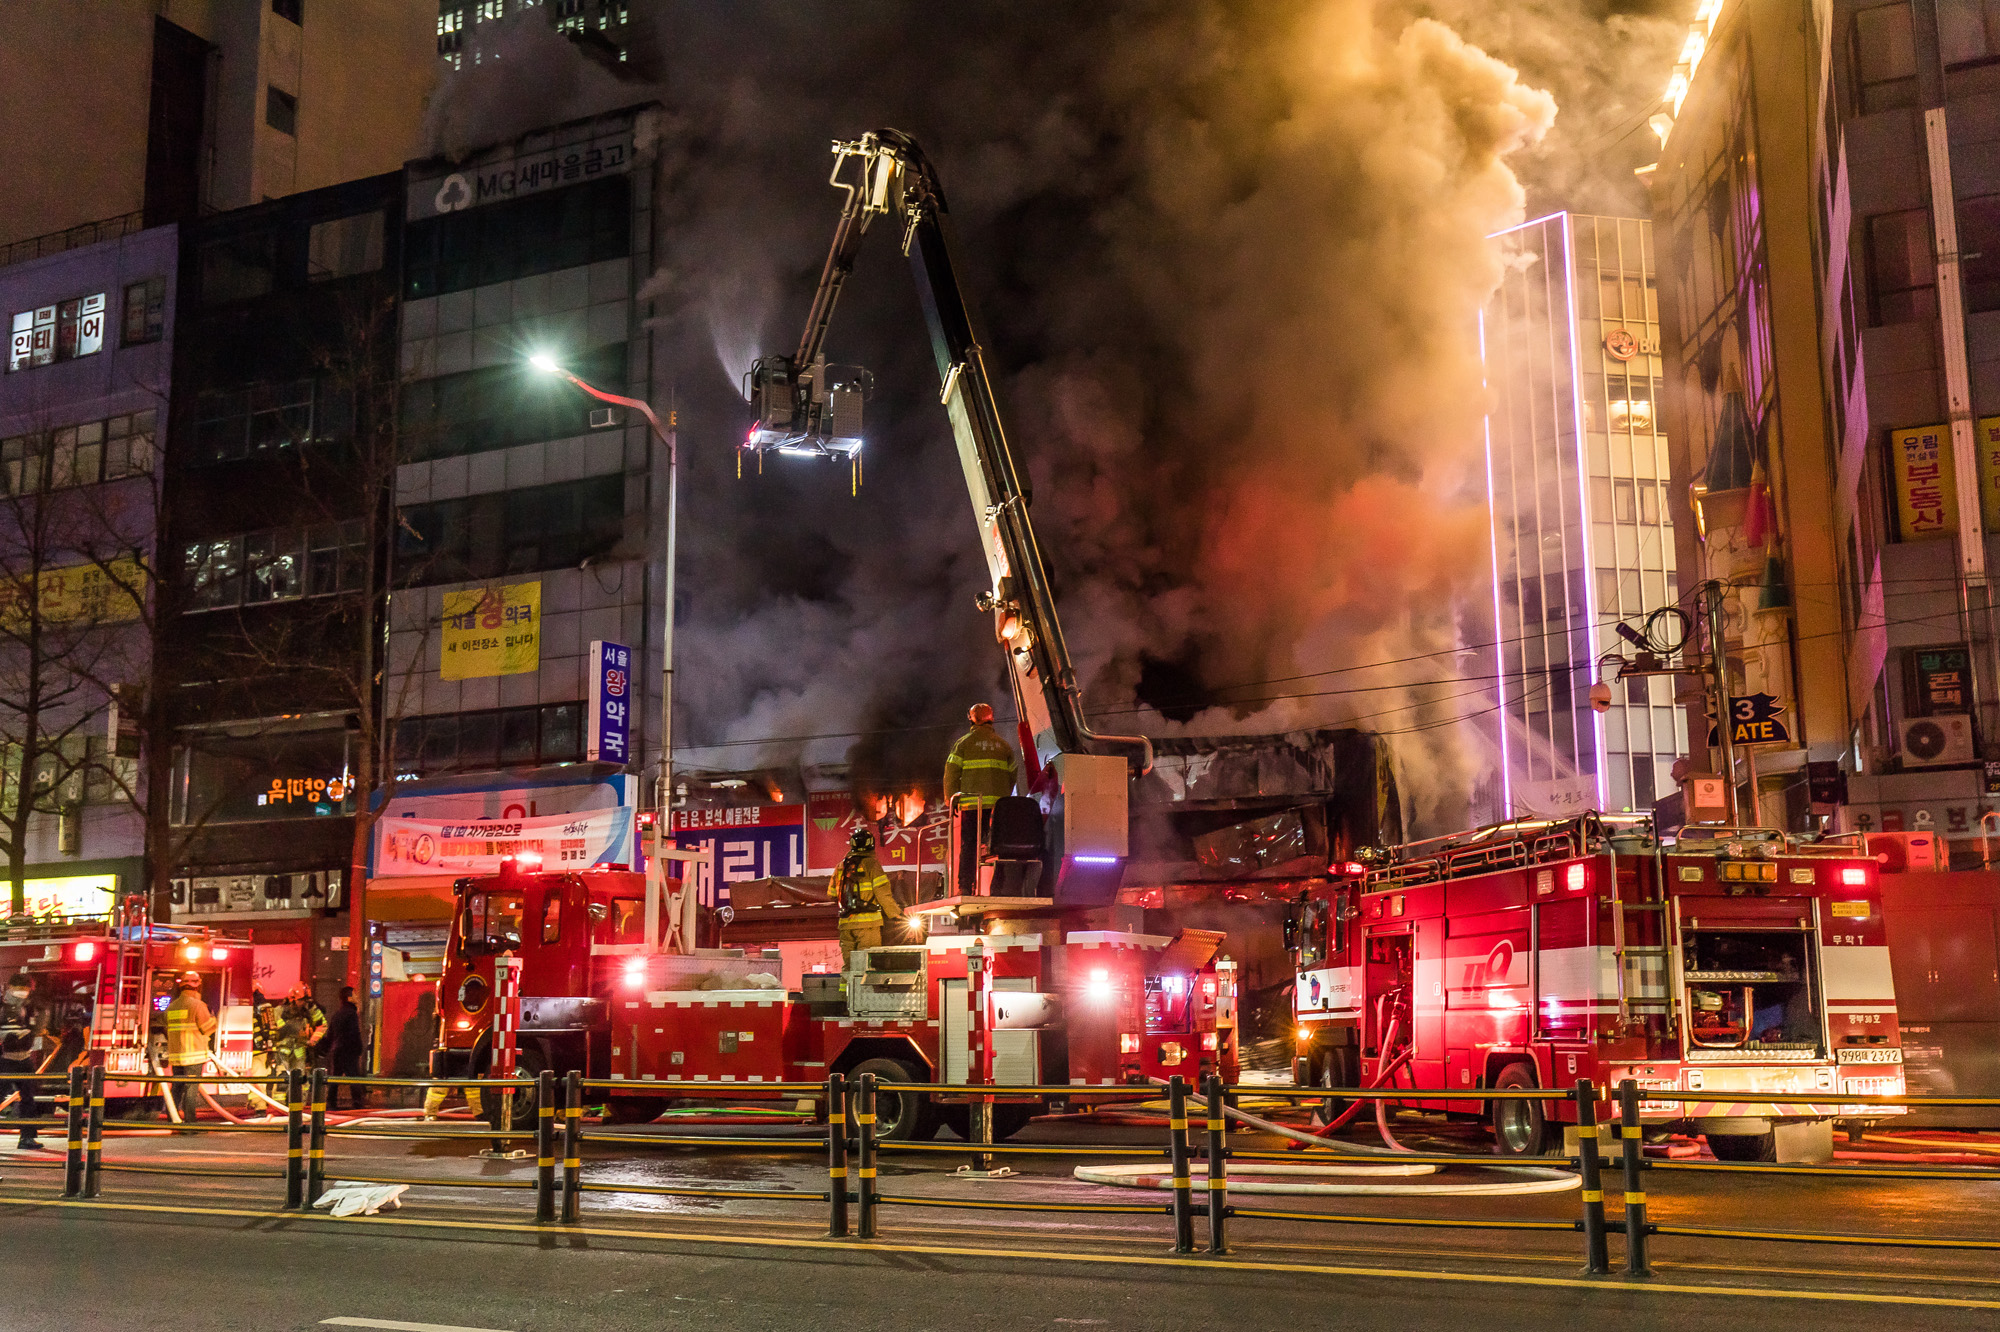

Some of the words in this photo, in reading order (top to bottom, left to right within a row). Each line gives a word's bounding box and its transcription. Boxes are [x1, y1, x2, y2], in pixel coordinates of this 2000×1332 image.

[1906, 462, 1947, 533] 부동산
[462, 637, 500, 652] 이전장소
[1735, 699, 1756, 721] 3
[1733, 721, 1775, 741] ATE
[1870, 1049, 1899, 1062] 2392
